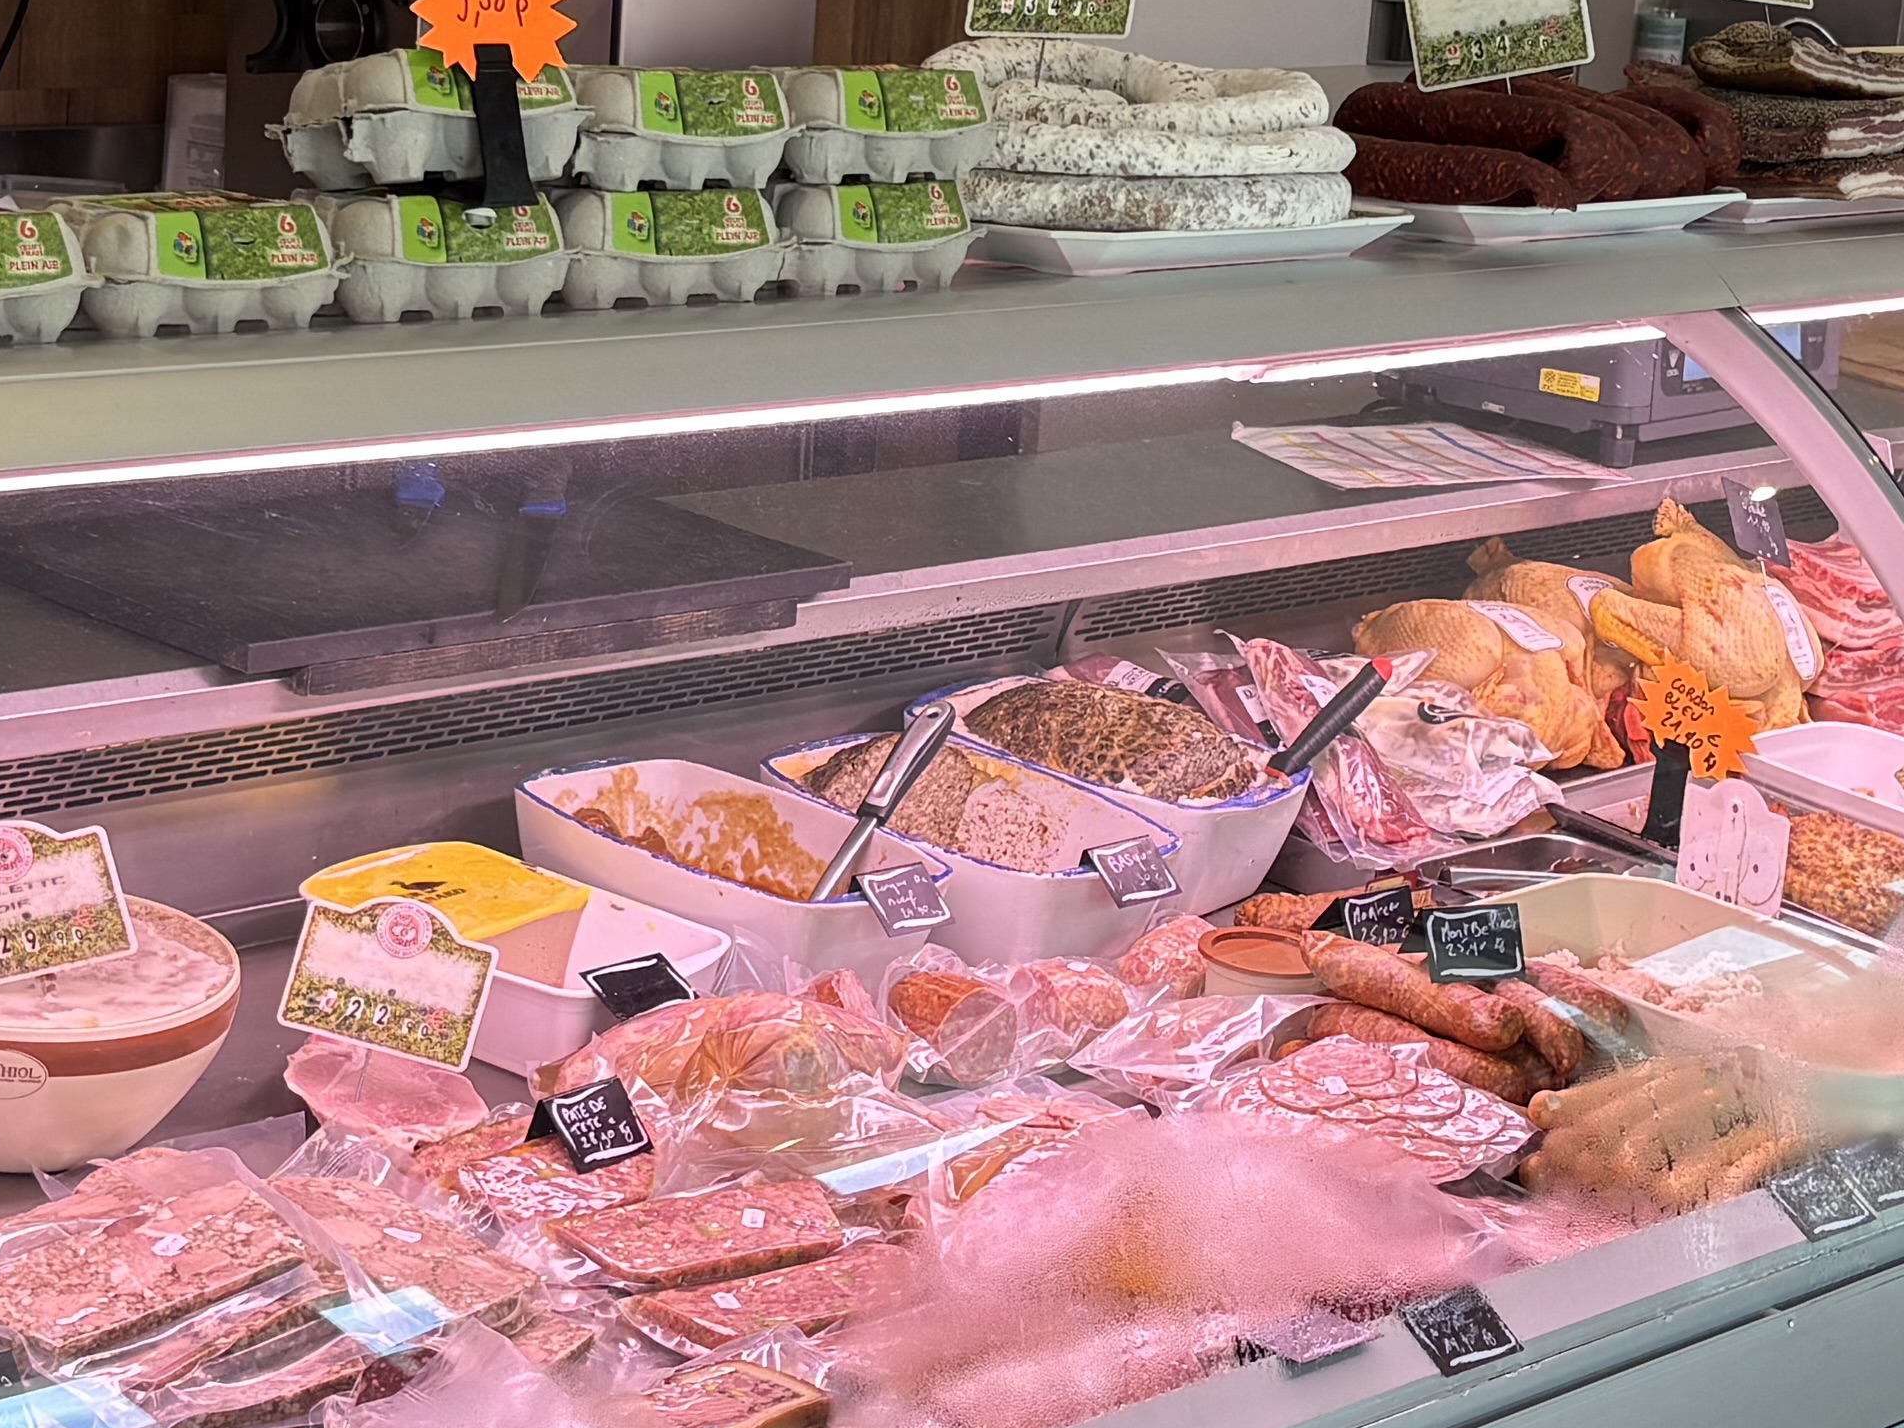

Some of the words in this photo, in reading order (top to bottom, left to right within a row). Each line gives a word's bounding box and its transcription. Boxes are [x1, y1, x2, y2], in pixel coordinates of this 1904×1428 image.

[940, 107, 964, 117] PLEIN
[736, 113, 759, 123] PLEIN
[926, 217, 947, 227] PLEIN
[19, 219, 37, 239] 6
[716, 232, 742, 241] PLEIN
[271, 254, 297, 264] PLEIN
[9, 259, 38, 270] PLEIN
[589, 1095, 609, 1114] DE
